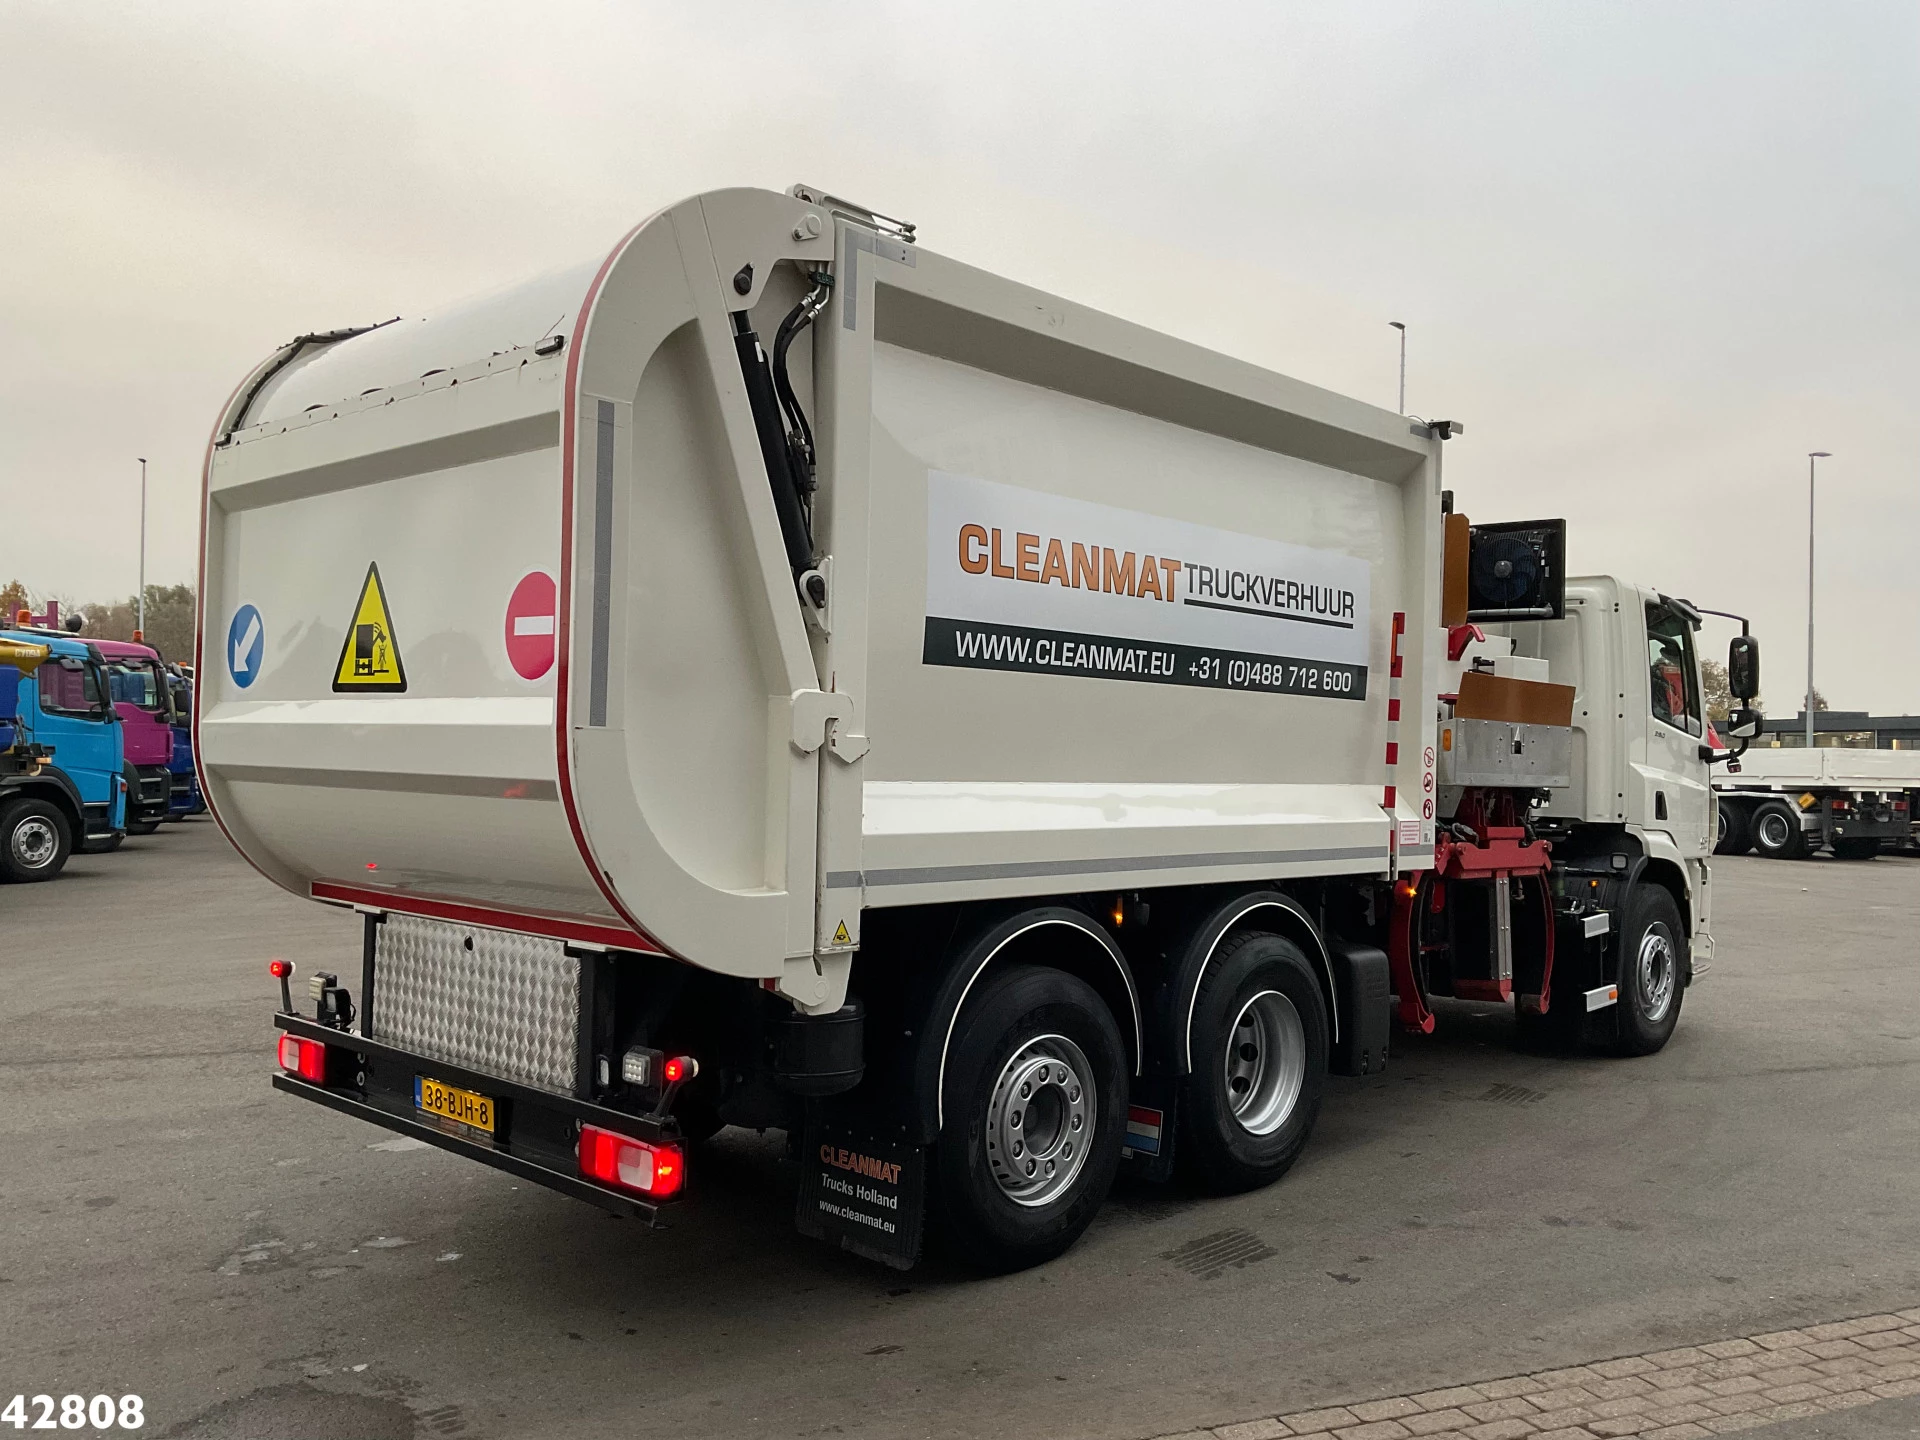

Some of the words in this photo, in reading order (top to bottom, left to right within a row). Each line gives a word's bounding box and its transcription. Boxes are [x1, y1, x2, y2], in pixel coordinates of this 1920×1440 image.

[958, 523, 1182, 603] CLEANMAT
[1184, 562, 1355, 619] TRUCKVERHUUR
[955, 630, 1176, 676] WWW.CLEANMAT.EU
[1188, 656, 1221, 680] +31
[1227, 659, 1283, 687] (0)488
[1288, 666, 1318, 689] 712
[1322, 670, 1352, 692] 600
[425, 1084, 489, 1125] 38-BJH-8
[820, 1144, 902, 1185] CLEANMAT
[822, 1172, 854, 1196] Trucks
[856, 1184, 898, 1210] Holland
[819, 1200, 896, 1234] www.cleanmat.eu
